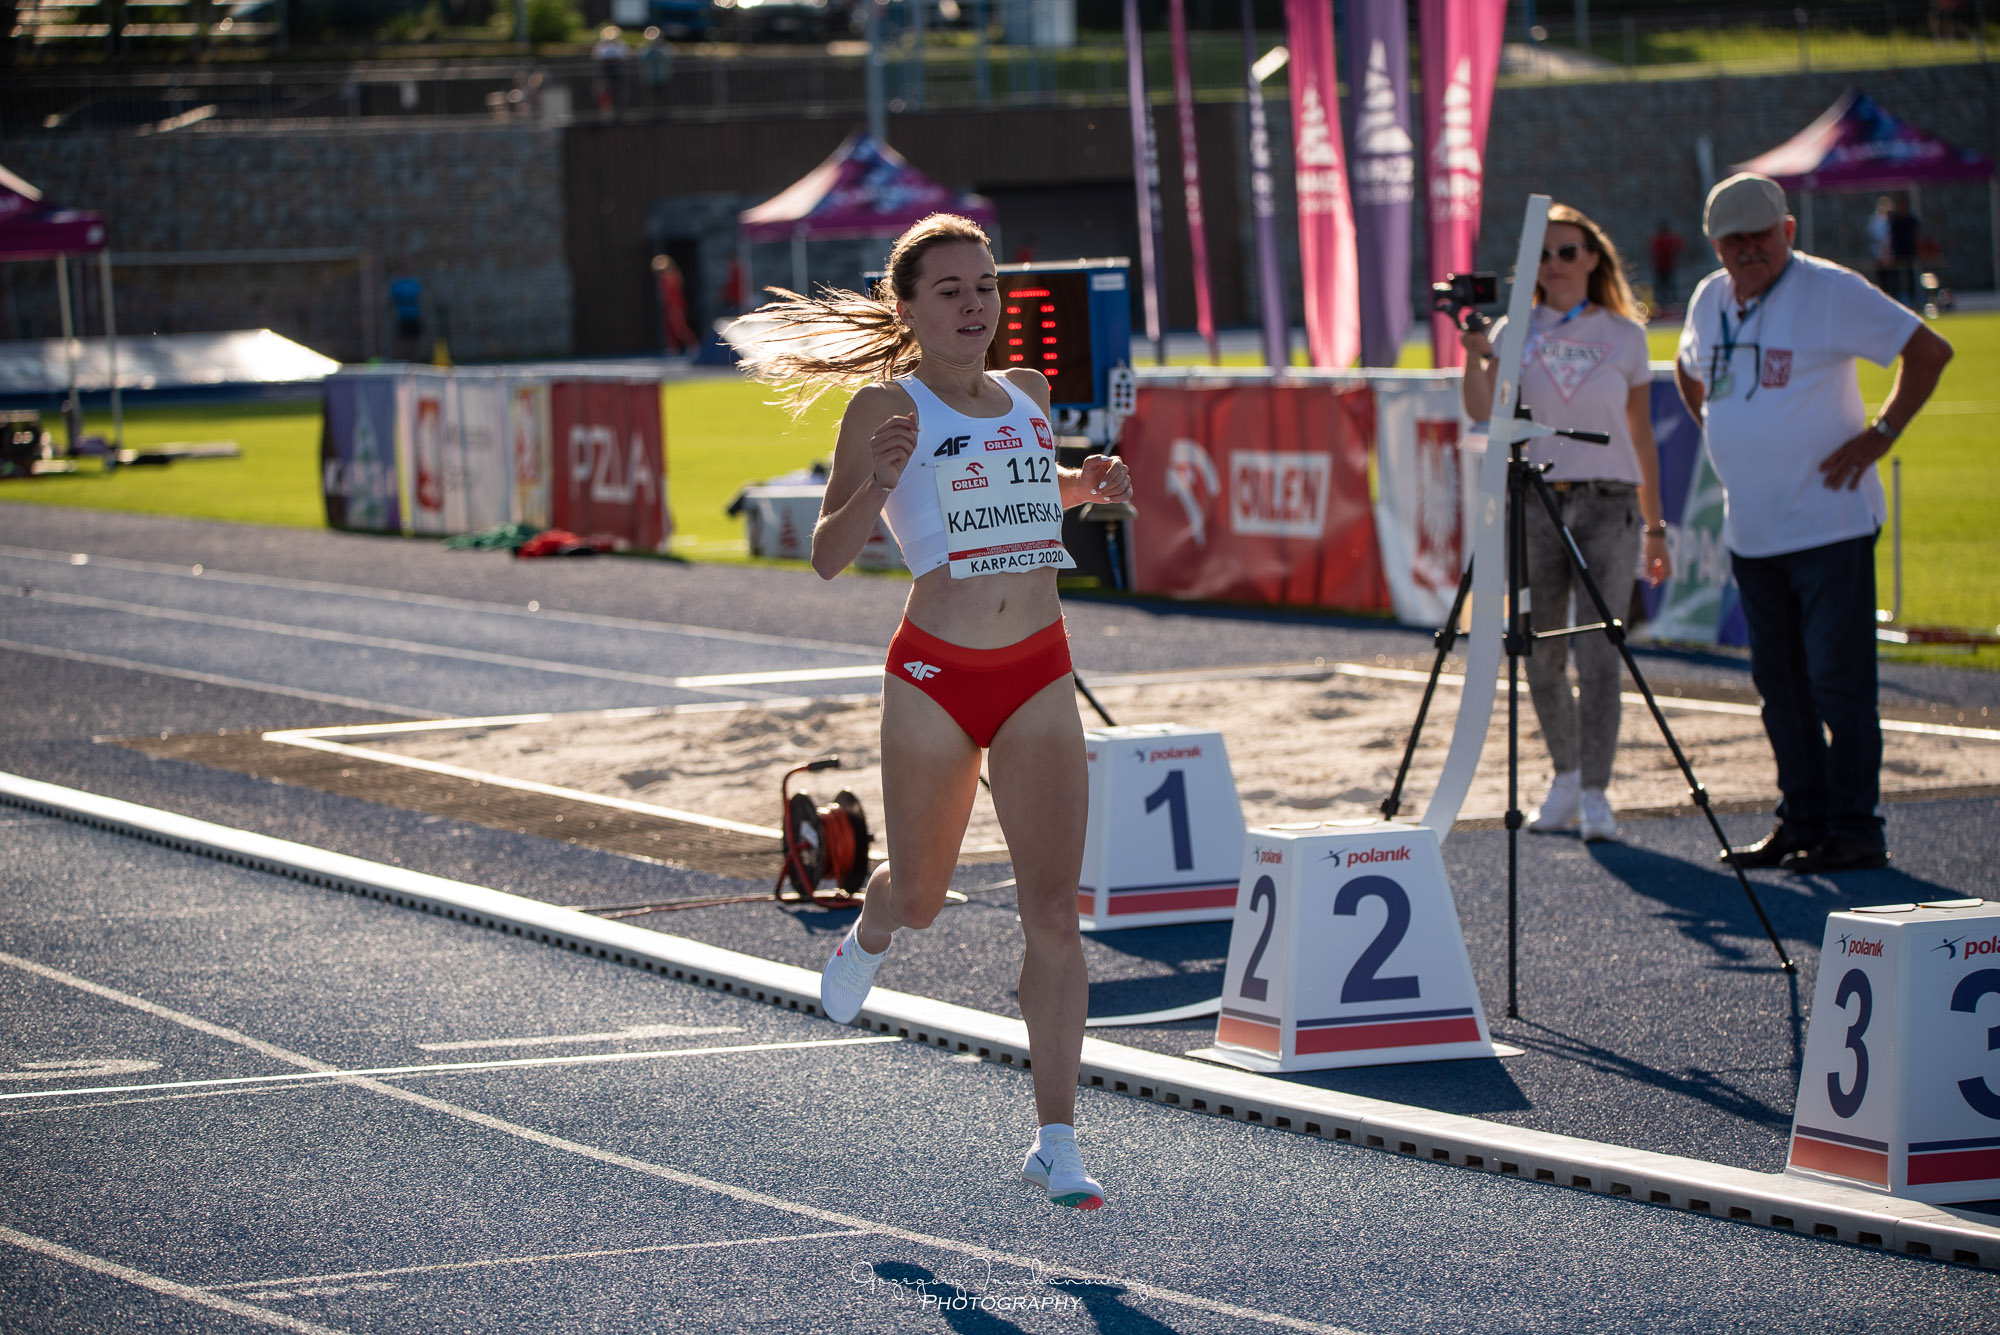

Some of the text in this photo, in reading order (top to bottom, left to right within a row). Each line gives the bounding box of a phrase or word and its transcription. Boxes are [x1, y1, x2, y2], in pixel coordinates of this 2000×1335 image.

[986, 439, 1021, 450] ORLEN
[1006, 456, 1052, 485] 112
[954, 478, 987, 490] ORLEN
[947, 502, 1063, 534] KAZIMIERSKA
[970, 550, 1064, 573] KARPACZ 2020
[1149, 744, 1203, 764] polanik
[1144, 769, 1195, 872] 1
[1260, 849, 1283, 865] polanik
[1347, 845, 1411, 868] polanik
[1239, 874, 1277, 1002] 2
[1333, 874, 1421, 1004] 2
[1848, 936, 1884, 958] polanik
[1827, 968, 1873, 1119] 3
